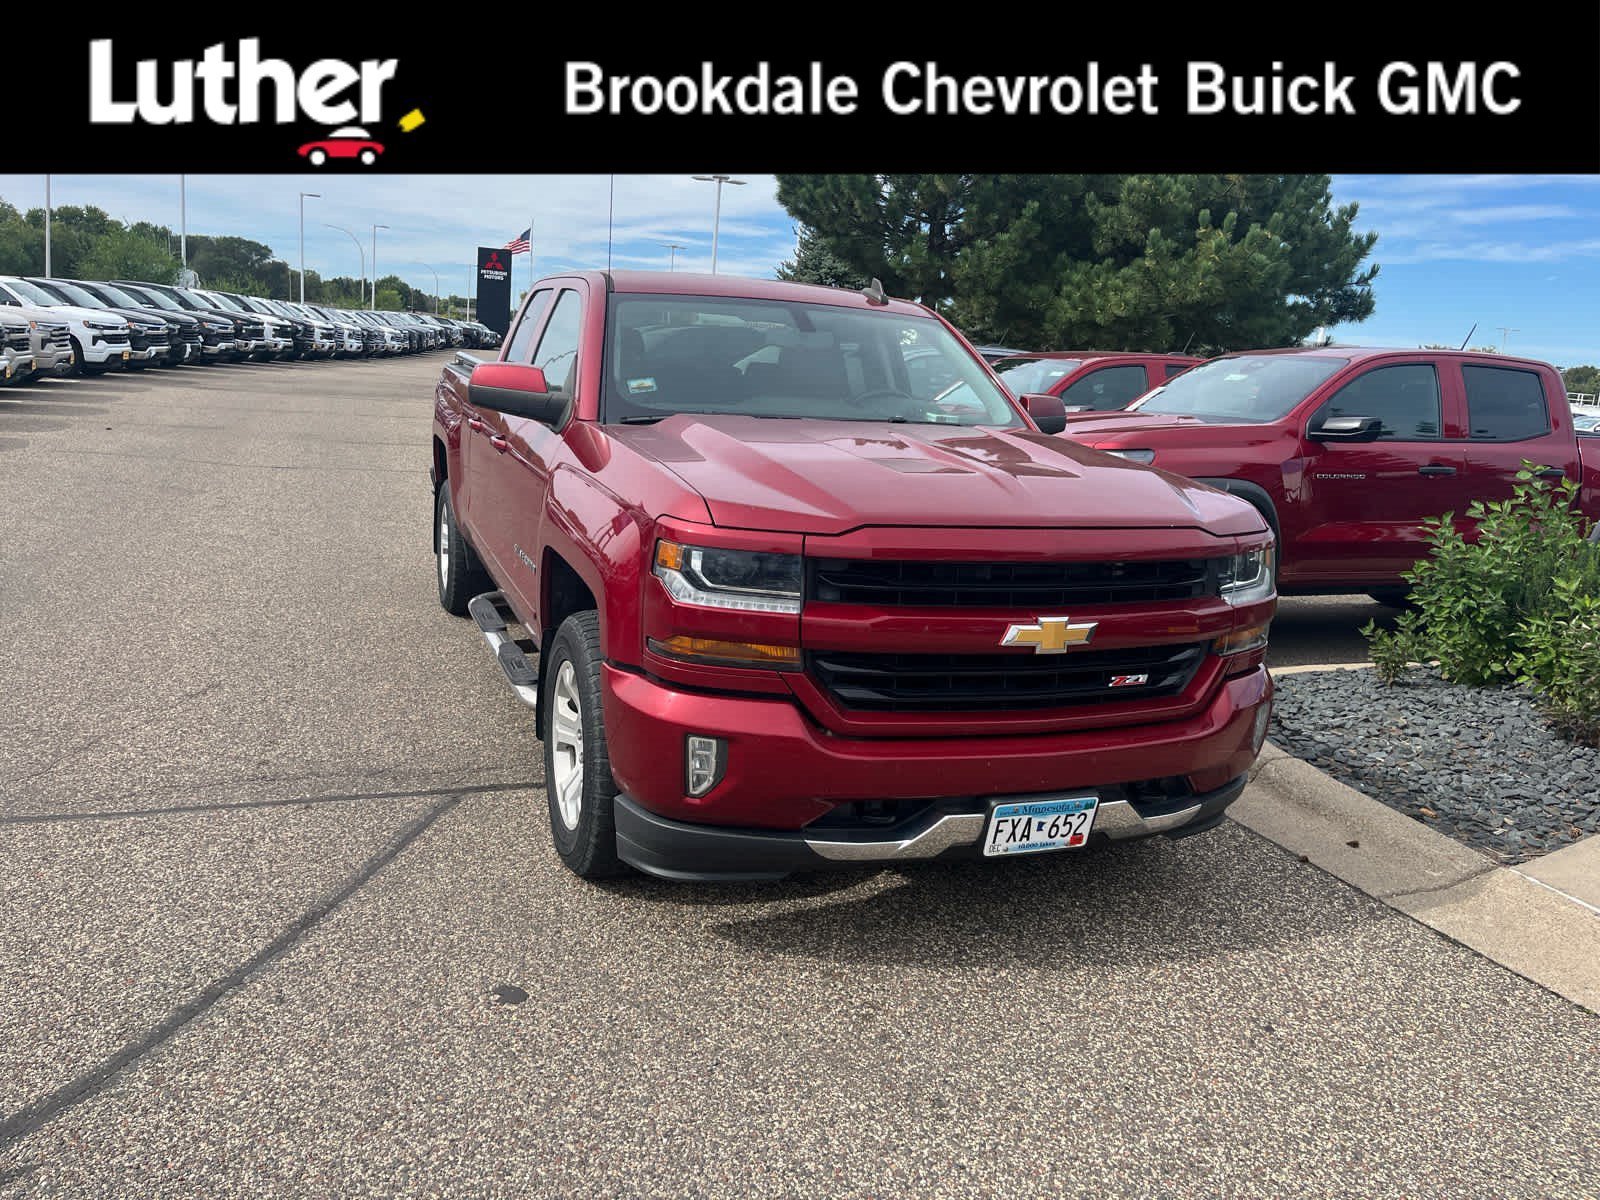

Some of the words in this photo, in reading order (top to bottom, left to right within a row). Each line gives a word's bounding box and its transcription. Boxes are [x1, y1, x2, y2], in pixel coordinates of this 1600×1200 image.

[1022, 804, 1071, 815] Minnesota
[992, 817, 1032, 845] FXA
[1047, 812, 1087, 839] 652
